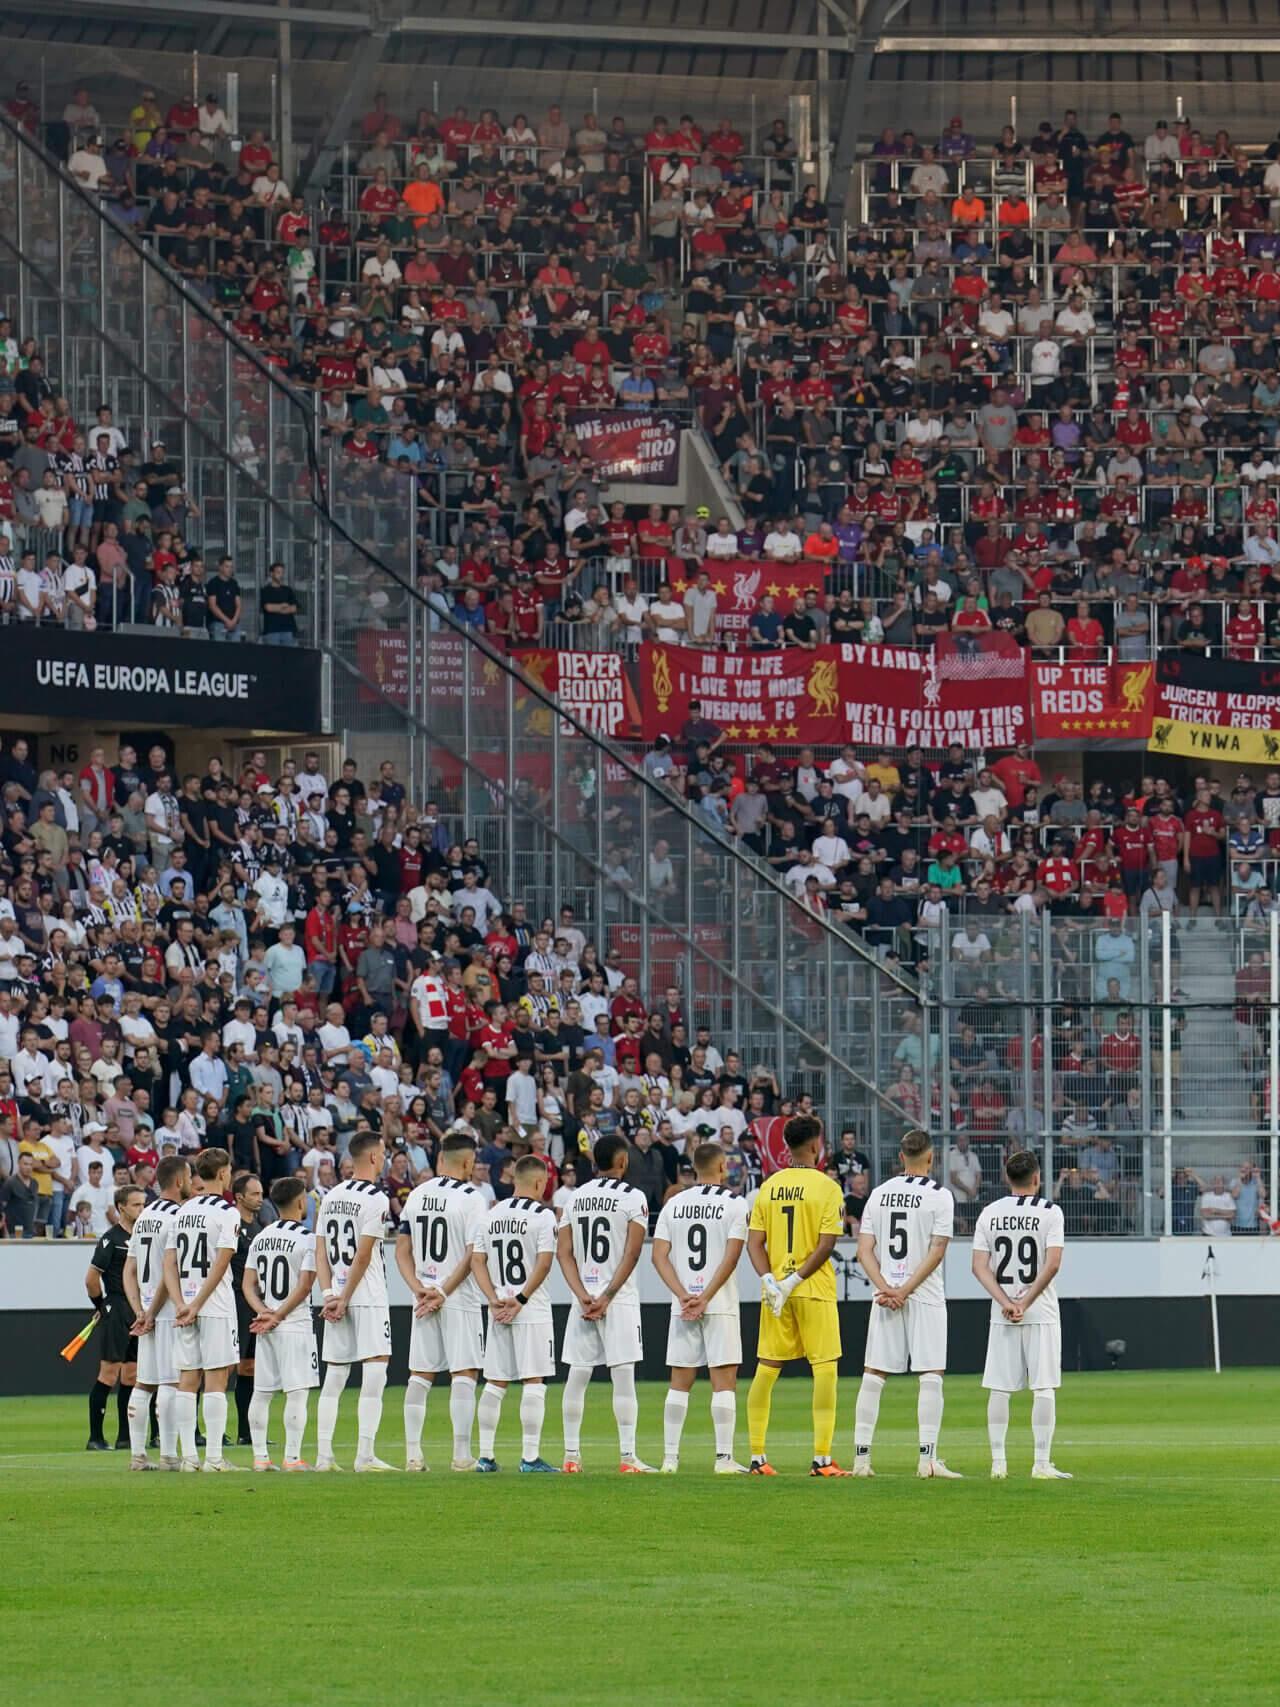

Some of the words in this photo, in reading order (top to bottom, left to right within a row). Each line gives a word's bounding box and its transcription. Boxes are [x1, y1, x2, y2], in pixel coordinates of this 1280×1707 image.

[574, 420, 603, 440] WE
[605, 416, 653, 434] FOLLOW
[557, 651, 622, 679] NEVER
[702, 655, 717, 674] IN
[724, 656, 744, 675] MY
[751, 656, 784, 675] LIFE
[841, 642, 867, 664] BY
[36, 659, 90, 689] UEFA
[94, 664, 170, 693] EUROPA
[174, 669, 249, 699] LEAGUE
[679, 672, 686, 692] I
[691, 675, 728, 697] LOVE
[734, 679, 762, 698] YOU
[767, 676, 806, 698] MORE
[1036, 667, 1066, 686] UP
[1070, 666, 1107, 685] THE
[558, 677, 624, 701] GONNA
[1041, 689, 1104, 714] REDS
[1161, 684, 1218, 708] JURGEN
[559, 701, 626, 737] STOP
[698, 699, 767, 721] IVERPOOL
[775, 700, 796, 721] FC
[844, 701, 896, 727] WE'LL
[900, 709, 976, 730] FOLLOW
[979, 705, 1025, 727] THIS
[1168, 704, 1222, 726] TRICKY
[1230, 711, 1273, 729] REDS
[851, 723, 897, 745] BIRD
[905, 725, 1017, 749] ANYWHERE
[1189, 729, 1241, 752] YNWA
[51, 744, 79, 764] N6
[421, 1196, 448, 1212] ŽULJ
[572, 1198, 619, 1213] ANDRADE
[770, 1185, 805, 1201] LAWAL
[879, 1192, 923, 1209] ZIEREIS
[178, 1214, 207, 1230] HAVEL
[673, 1203, 724, 1221] LJUBIČIĆ
[990, 1216, 1041, 1232] FLECKER
[415, 1214, 449, 1264] 10
[488, 1218, 528, 1236] JOVIČIĆ
[577, 1215, 610, 1264] 16
[781, 1205, 795, 1254] 1
[889, 1212, 908, 1261] 5
[176, 1232, 211, 1279] 24
[253, 1236, 297, 1254] HORVATH
[326, 1219, 358, 1267] 33
[687, 1223, 708, 1272] 9
[140, 1237, 153, 1283] 7
[491, 1239, 528, 1286] 18
[994, 1235, 1039, 1286] 29
[256, 1254, 290, 1302] 30
